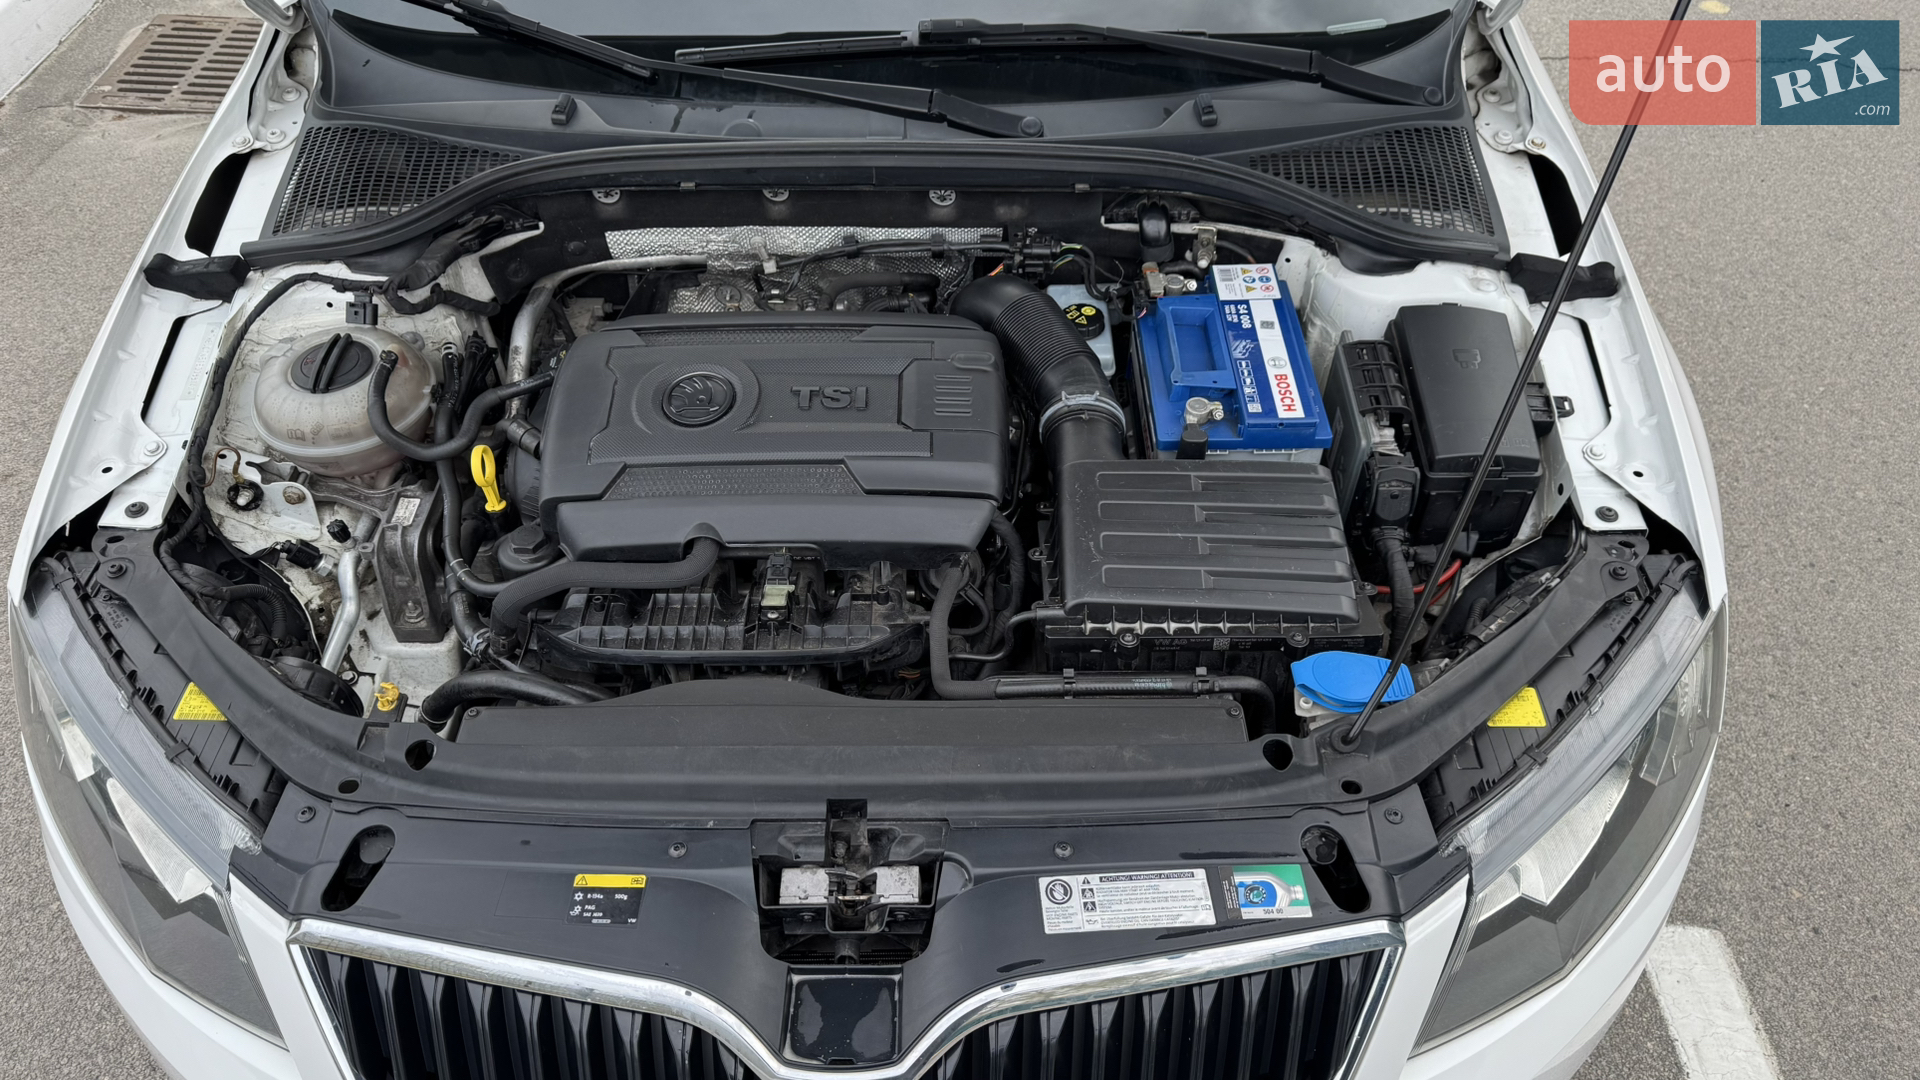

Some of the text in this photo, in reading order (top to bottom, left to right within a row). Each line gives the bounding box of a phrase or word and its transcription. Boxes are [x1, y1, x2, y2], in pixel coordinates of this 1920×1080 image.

[1237, 304, 1252, 329] S4 008
[791, 386, 868, 410] TSI
[1274, 373, 1297, 412] BOSCH
[1101, 872, 1194, 883] ACHTUNG! WARNING! ATTENTION!
